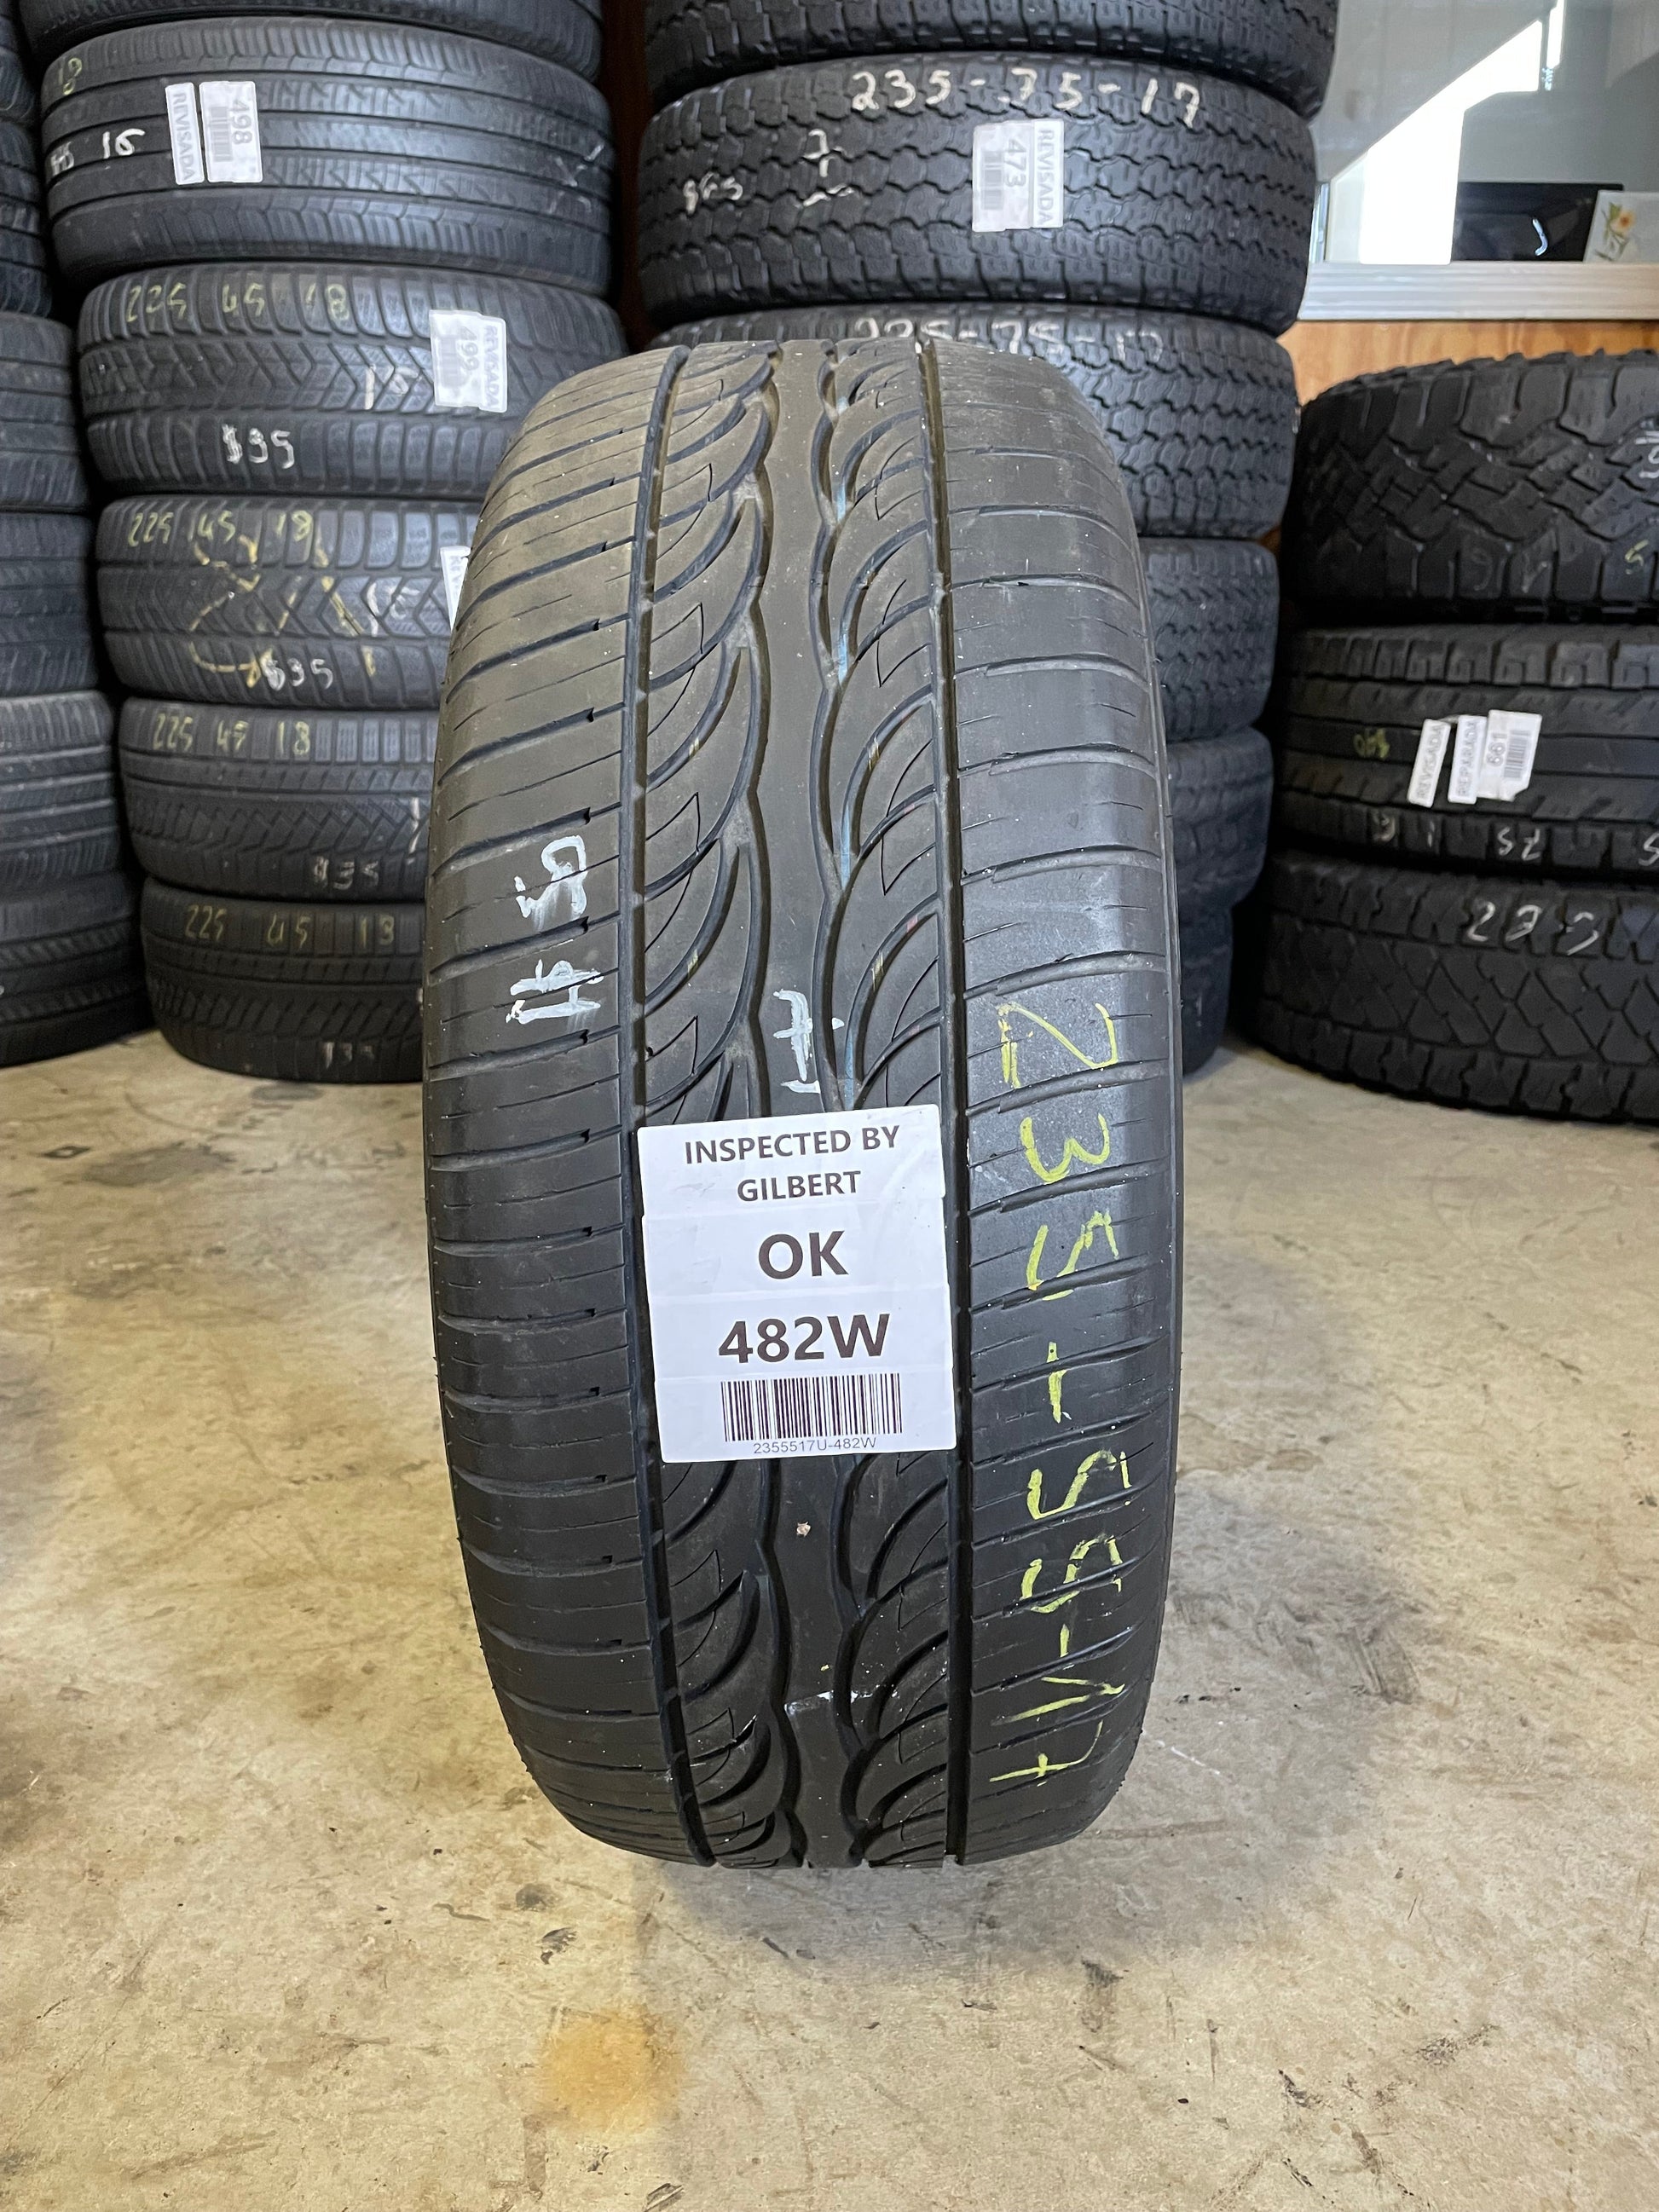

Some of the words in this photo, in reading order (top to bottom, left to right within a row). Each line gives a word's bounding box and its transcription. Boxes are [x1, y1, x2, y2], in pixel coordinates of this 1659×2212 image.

[172, 92, 196, 182] REVISADA
[232, 99, 253, 146] 498
[1004, 137, 1027, 188] 473
[1038, 129, 1055, 224] REVISADA
[126, 282, 186, 322] 225
[305, 282, 350, 321] 18
[461, 326, 480, 375] 499
[483, 325, 500, 407] REVISADA
[128, 511, 174, 547] 225
[276, 510, 313, 542] 18
[153, 713, 194, 752] 225
[278, 720, 311, 756] 18
[1486, 733, 1507, 767] 661
[1416, 725, 1445, 800] REVISADA
[1458, 721, 1478, 797] REPARADA
[185, 904, 228, 942] 225
[685, 1129, 852, 1164] INSPECTED
[862, 1125, 900, 1150] BY
[737, 1171, 862, 1202] GILBERT
[758, 1230, 849, 1279] OK
[718, 1313, 891, 1364] 482W
[753, 1435, 877, 1454] 2355517U-482W
